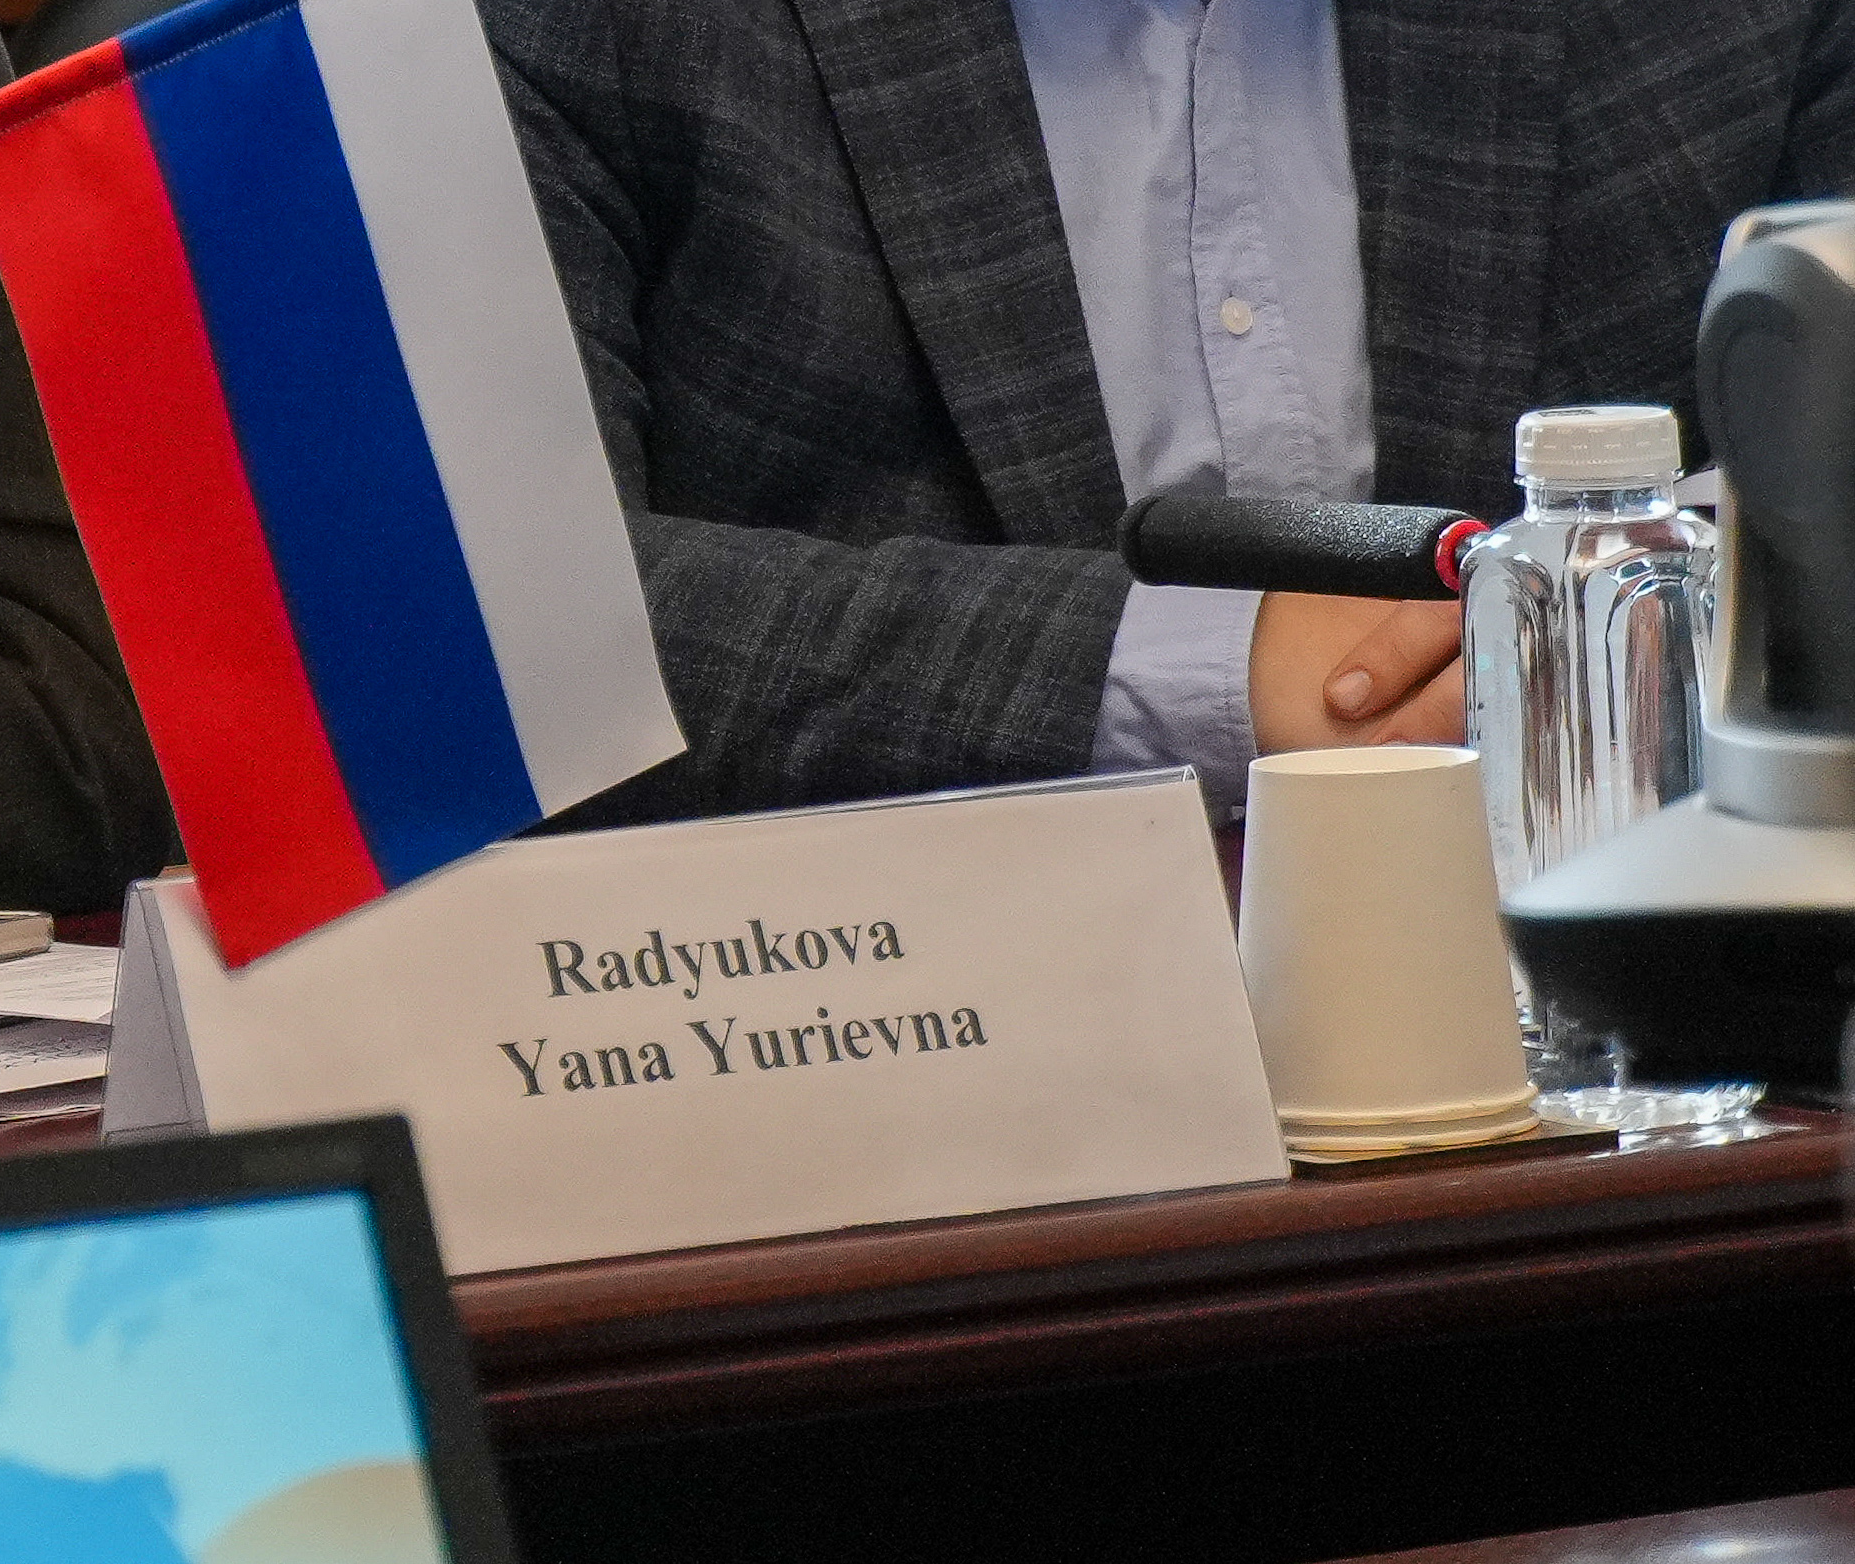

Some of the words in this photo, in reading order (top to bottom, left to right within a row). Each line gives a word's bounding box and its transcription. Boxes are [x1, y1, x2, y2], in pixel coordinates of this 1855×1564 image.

[537, 918, 905, 1000] Radyukova
[497, 1038, 676, 1098] Yana
[686, 1006, 990, 1077] Yurievna
